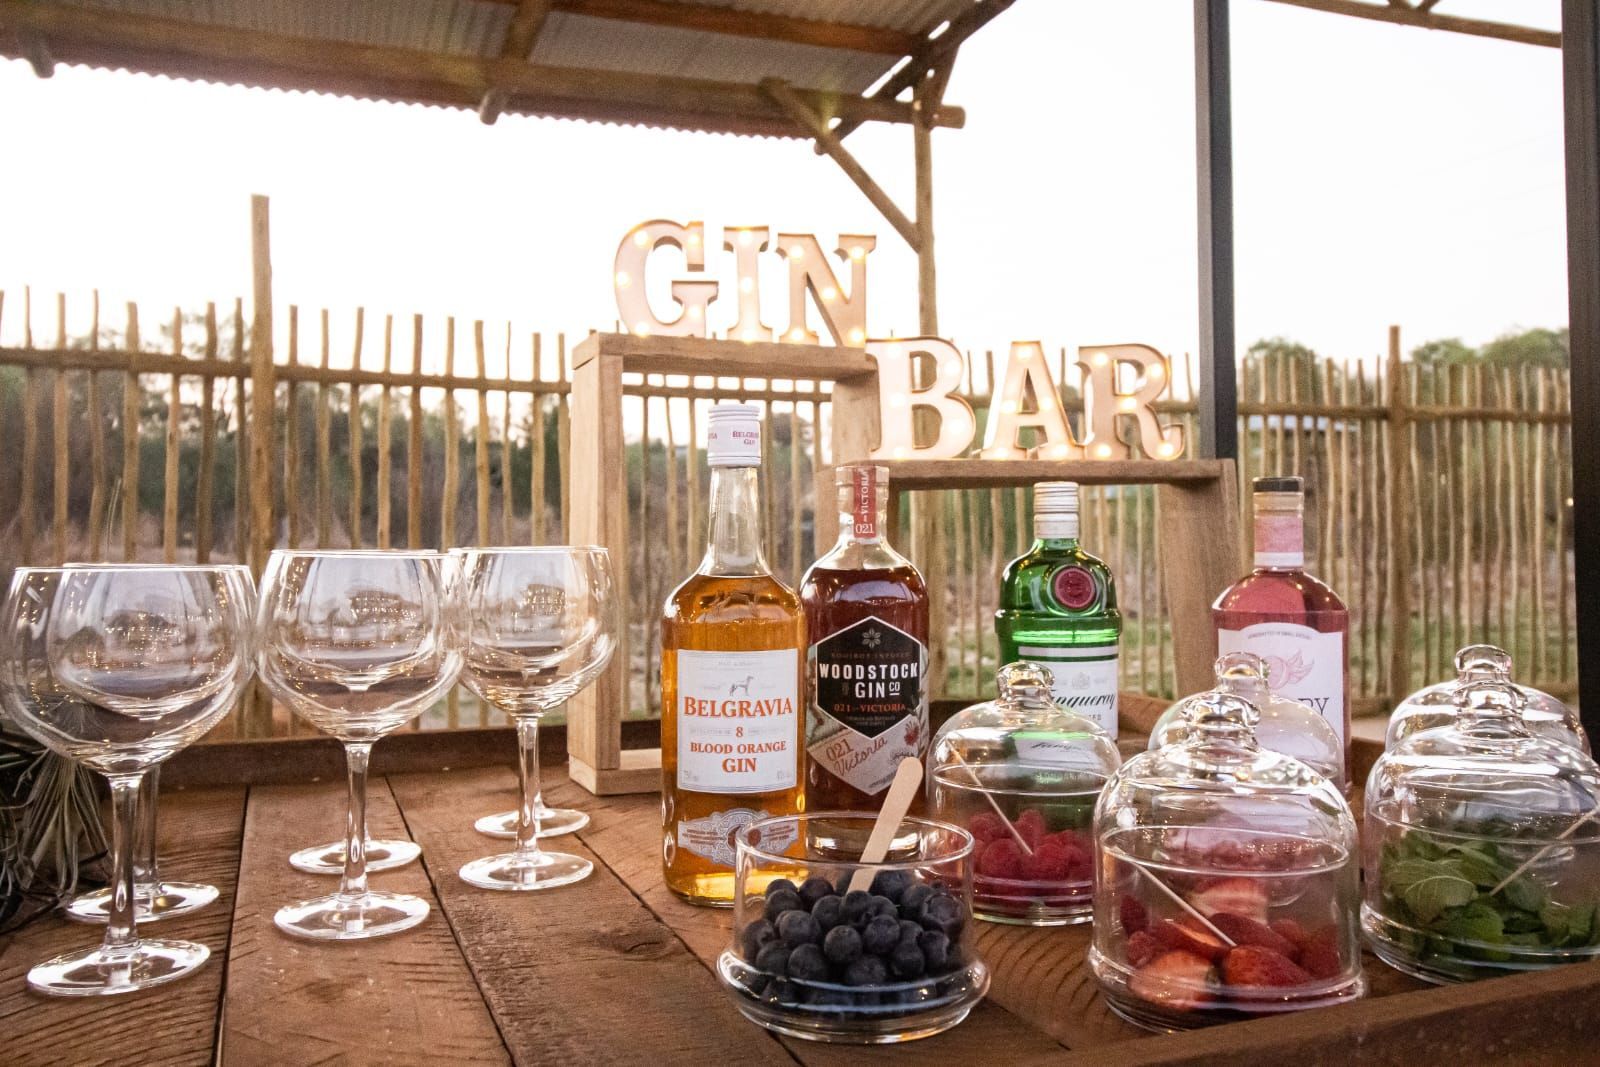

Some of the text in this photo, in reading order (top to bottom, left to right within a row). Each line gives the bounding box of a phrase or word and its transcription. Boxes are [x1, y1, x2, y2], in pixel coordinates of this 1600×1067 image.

[614, 219, 877, 347] GIN
[866, 337, 1183, 461] BAR
[855, 523, 874, 534] 021
[819, 662, 918, 680] WOODSTOCK
[855, 682, 885, 698] GIN
[684, 696, 793, 718] BELGRAVIA
[834, 702, 906, 714] 021 VICTORIA
[735, 726, 744, 738] 8
[690, 740, 787, 755] BLOOD ORANGE
[826, 738, 854, 762] 021
[722, 757, 757, 773] GIN
[834, 736, 888, 777] Victoria
